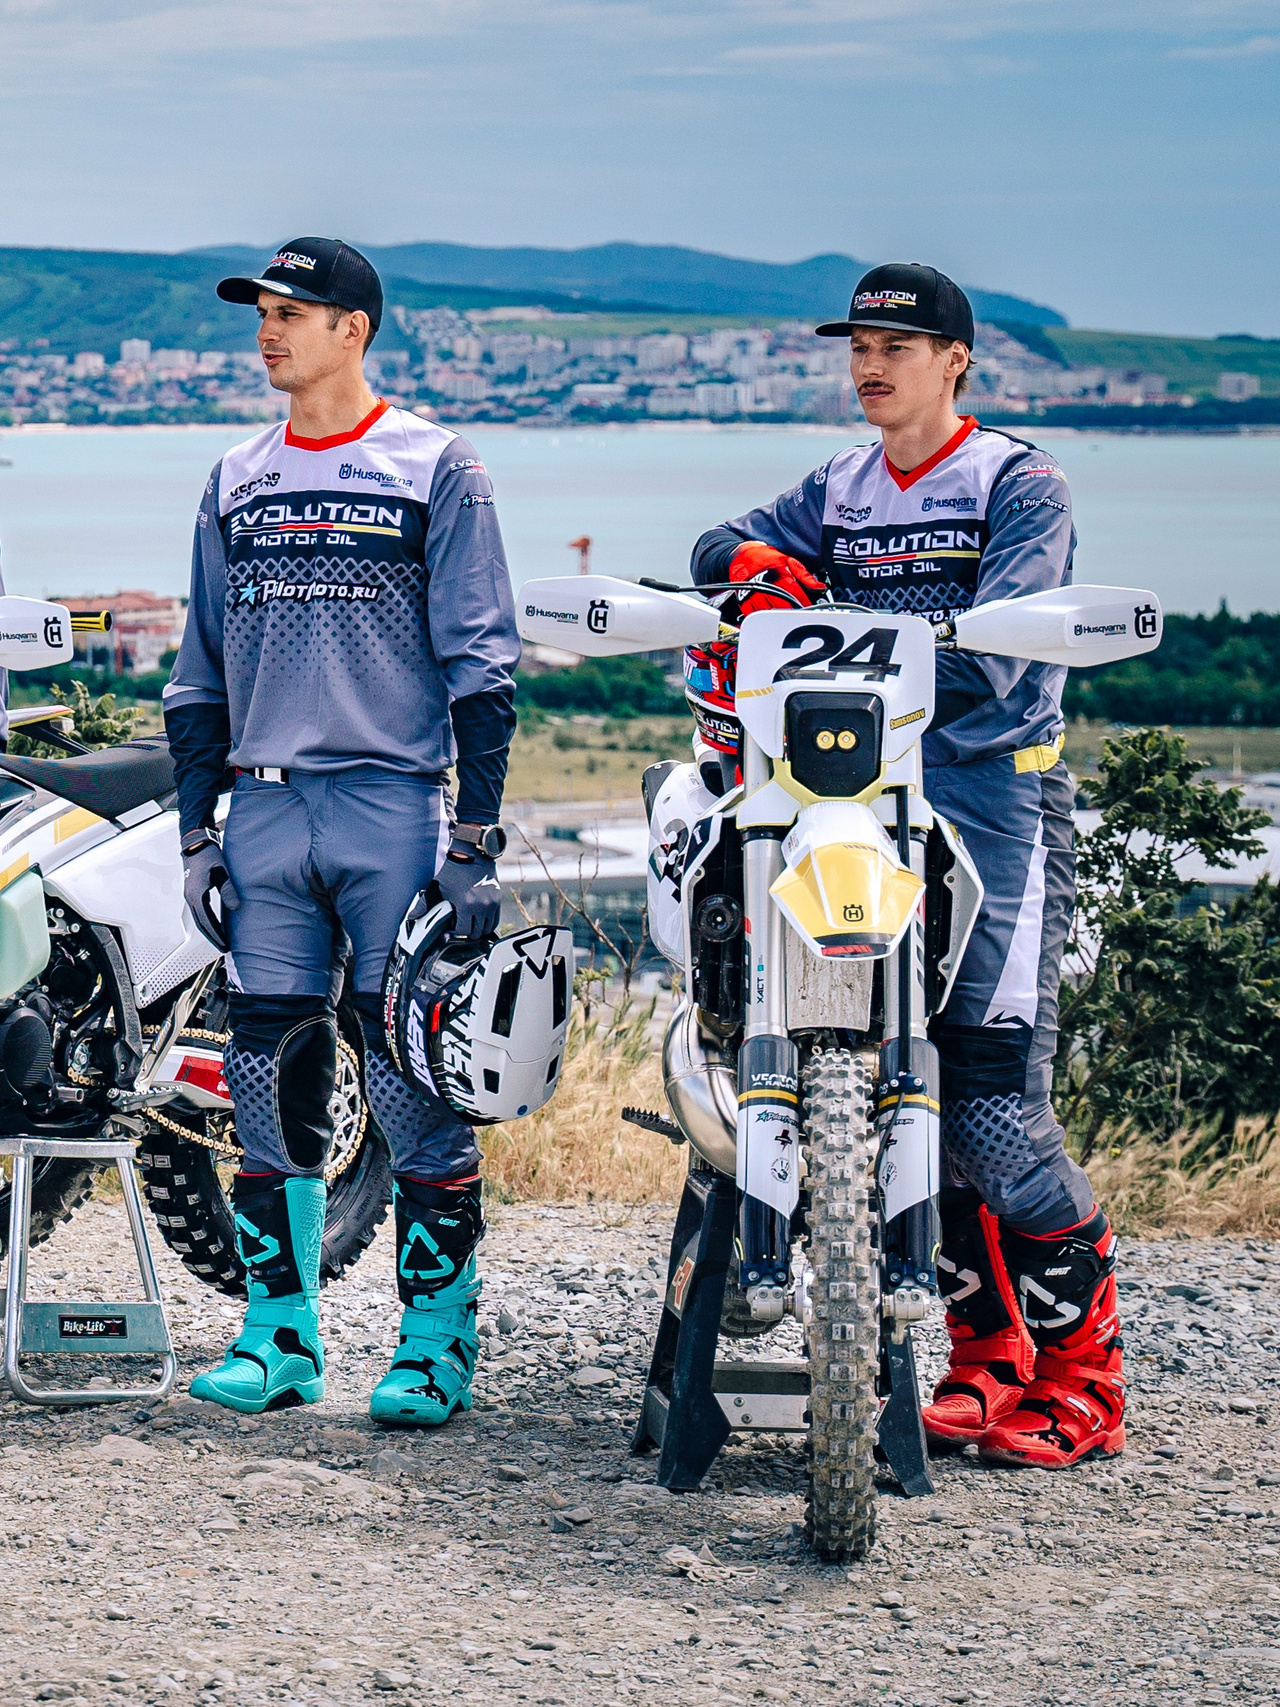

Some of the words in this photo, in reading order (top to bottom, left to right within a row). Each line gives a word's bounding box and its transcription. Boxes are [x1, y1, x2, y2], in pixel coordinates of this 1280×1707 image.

[275, 251, 317, 267] UTION
[854, 290, 917, 304] EVOLUTION
[352, 467, 413, 488] Husqvarna
[932, 496, 977, 509] Husqvarna
[231, 501, 403, 534] EVOLUTION
[253, 533, 317, 548] MOTOR
[326, 533, 357, 546] OIL
[913, 562, 941, 574] OIL
[536, 608, 579, 621] Husqvarna
[2, 632, 38, 642] Husqvarna
[1083, 624, 1126, 635] Husqvarna
[772, 624, 902, 683] 24
[709, 662, 720, 691] LEATT
[406, 998, 440, 1098] LEATT
[1045, 1266, 1072, 1276] LEATT
[63, 1320, 106, 1335] Bike-Lift
